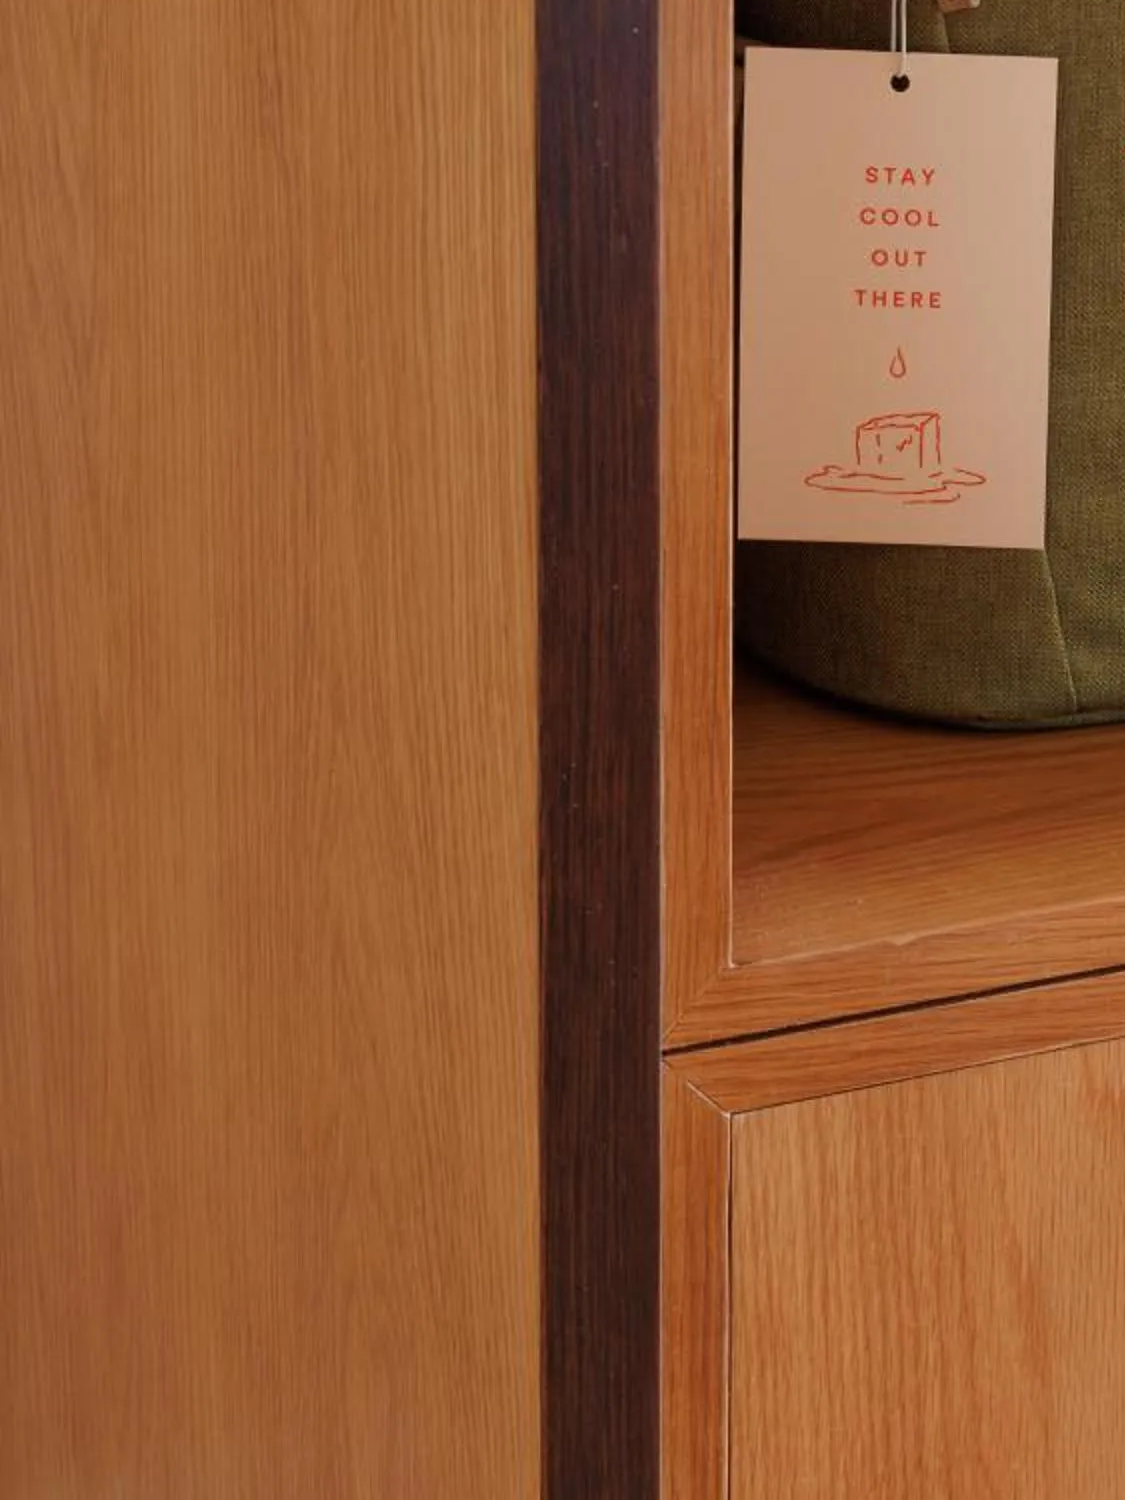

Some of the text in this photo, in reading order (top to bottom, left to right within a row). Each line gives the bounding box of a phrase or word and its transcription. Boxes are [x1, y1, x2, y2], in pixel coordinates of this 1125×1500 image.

[865, 167, 935, 186] STAY
[859, 209, 939, 227] COOL
[871, 249, 926, 267] OUT
[855, 290, 941, 309] THERE
